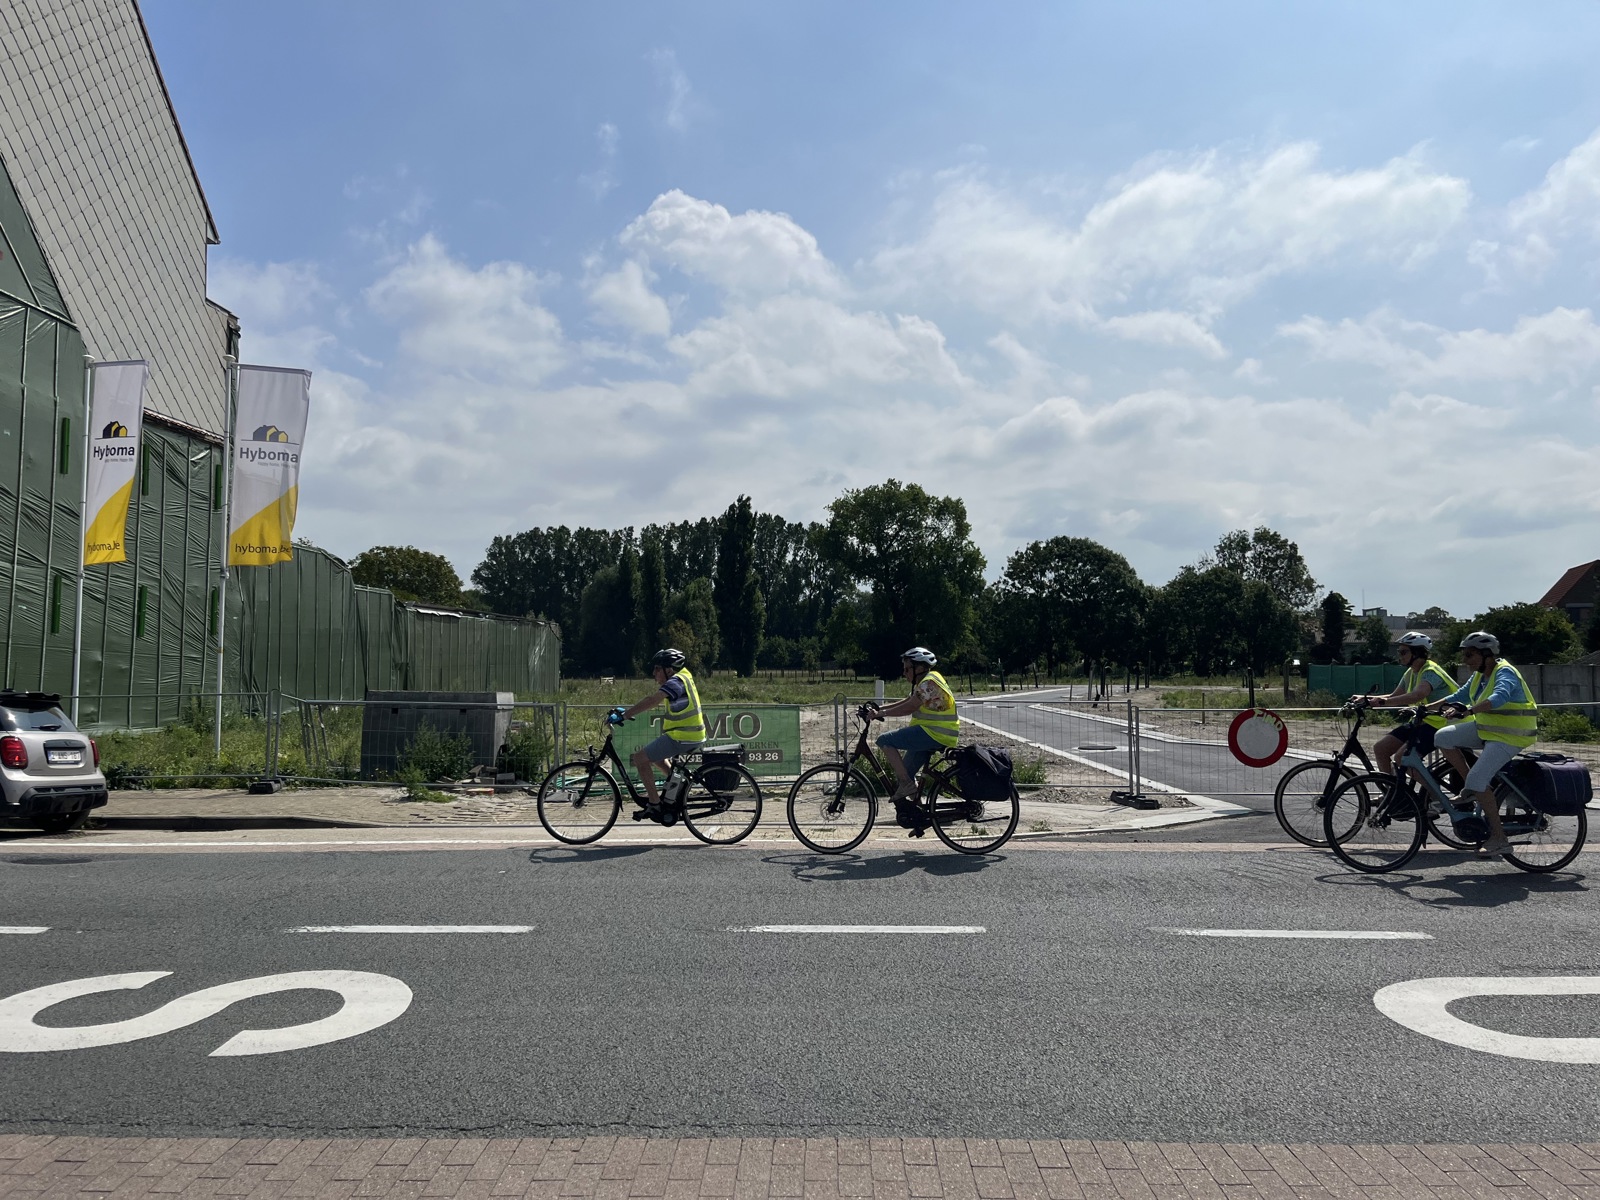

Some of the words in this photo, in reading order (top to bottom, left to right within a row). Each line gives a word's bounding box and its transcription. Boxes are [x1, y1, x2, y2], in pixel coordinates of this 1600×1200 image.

[240, 447, 299, 463] Hyboma
[650, 712, 762, 741] TMO
[748, 753, 762, 762] 93
[765, 752, 779, 761] 26
